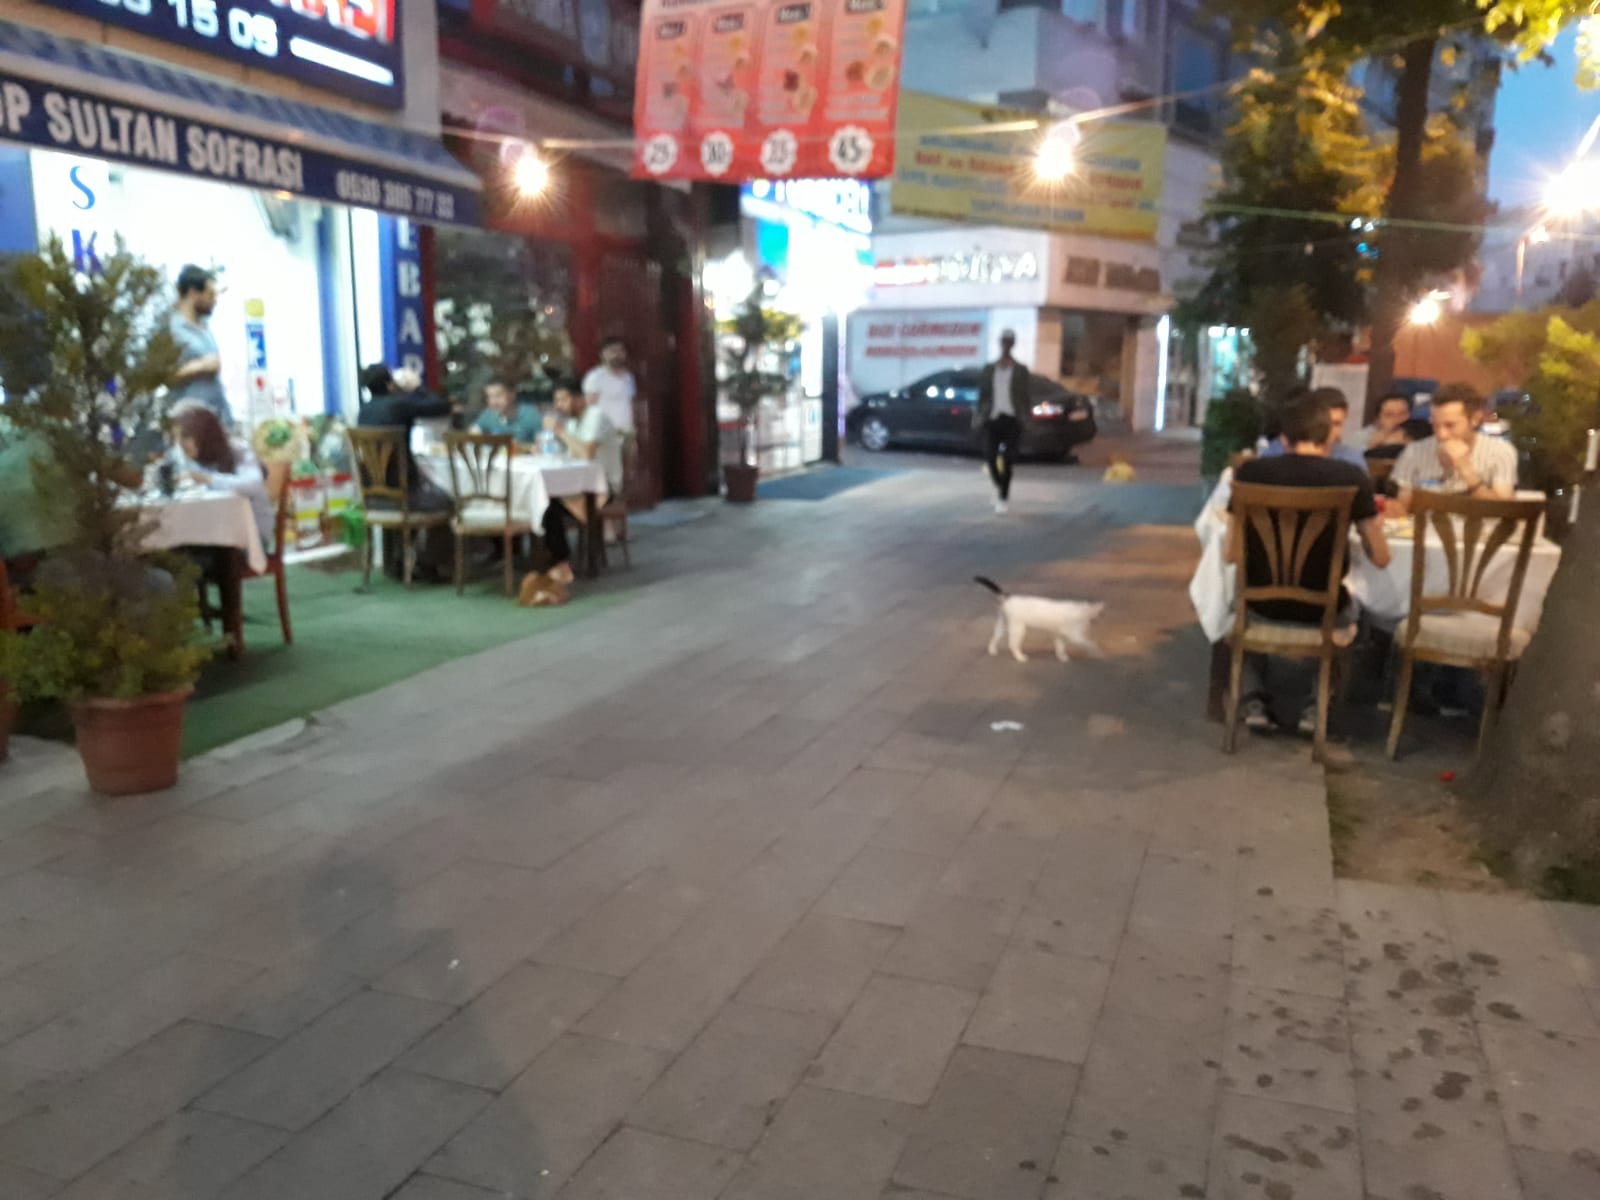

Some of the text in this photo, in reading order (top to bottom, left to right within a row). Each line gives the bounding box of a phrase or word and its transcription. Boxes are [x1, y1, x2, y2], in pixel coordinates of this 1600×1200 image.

[0, 81, 31, 133] P
[44, 92, 178, 164] SULTAN
[836, 135, 863, 165] 45
